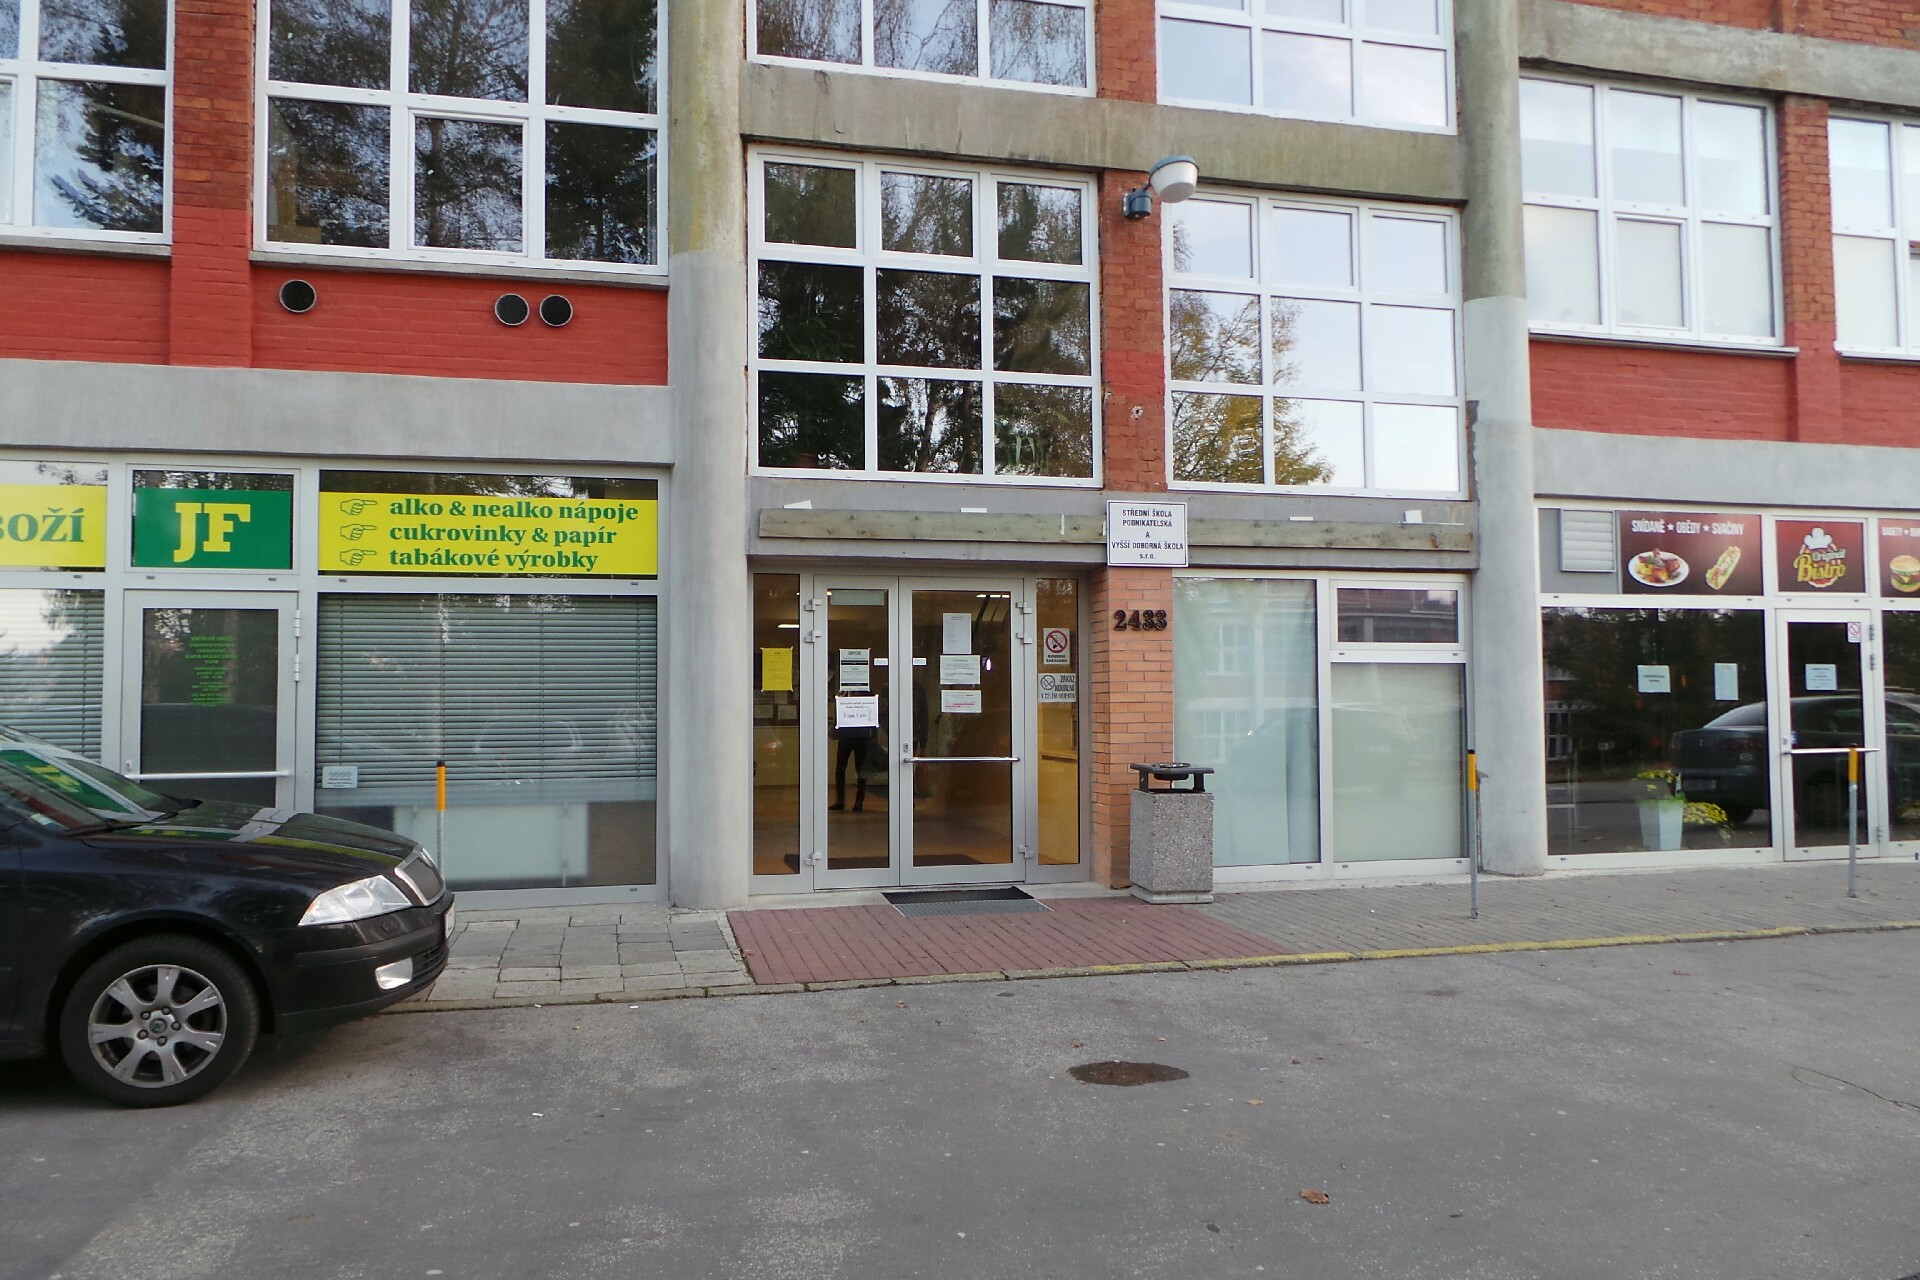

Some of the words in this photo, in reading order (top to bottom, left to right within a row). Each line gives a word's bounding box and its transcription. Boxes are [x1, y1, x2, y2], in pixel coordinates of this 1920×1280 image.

[389, 498, 444, 516] alko
[449, 500, 466, 516] &
[472, 500, 553, 518] nealko
[558, 501, 639, 524] nápoje
[1122, 507, 1150, 517] STŘEDNÍ
[1152, 508, 1172, 518] ŠKOLA
[0, 507, 85, 543] OŽÍ
[173, 502, 251, 563] JF
[389, 523, 527, 546] cukrovinky
[531, 527, 549, 543] &
[553, 525, 617, 547] papír
[1145, 530, 1150, 538] A
[1111, 539, 1131, 549] VYŠŠÍ
[1132, 541, 1162, 550] ODBORNÁ
[1164, 540, 1184, 550] ŠKOLA
[389, 547, 500, 566] tabákové
[505, 549, 599, 572] výrobky
[1793, 553, 1847, 582] Bistro
[1113, 609, 1168, 631] 2433
